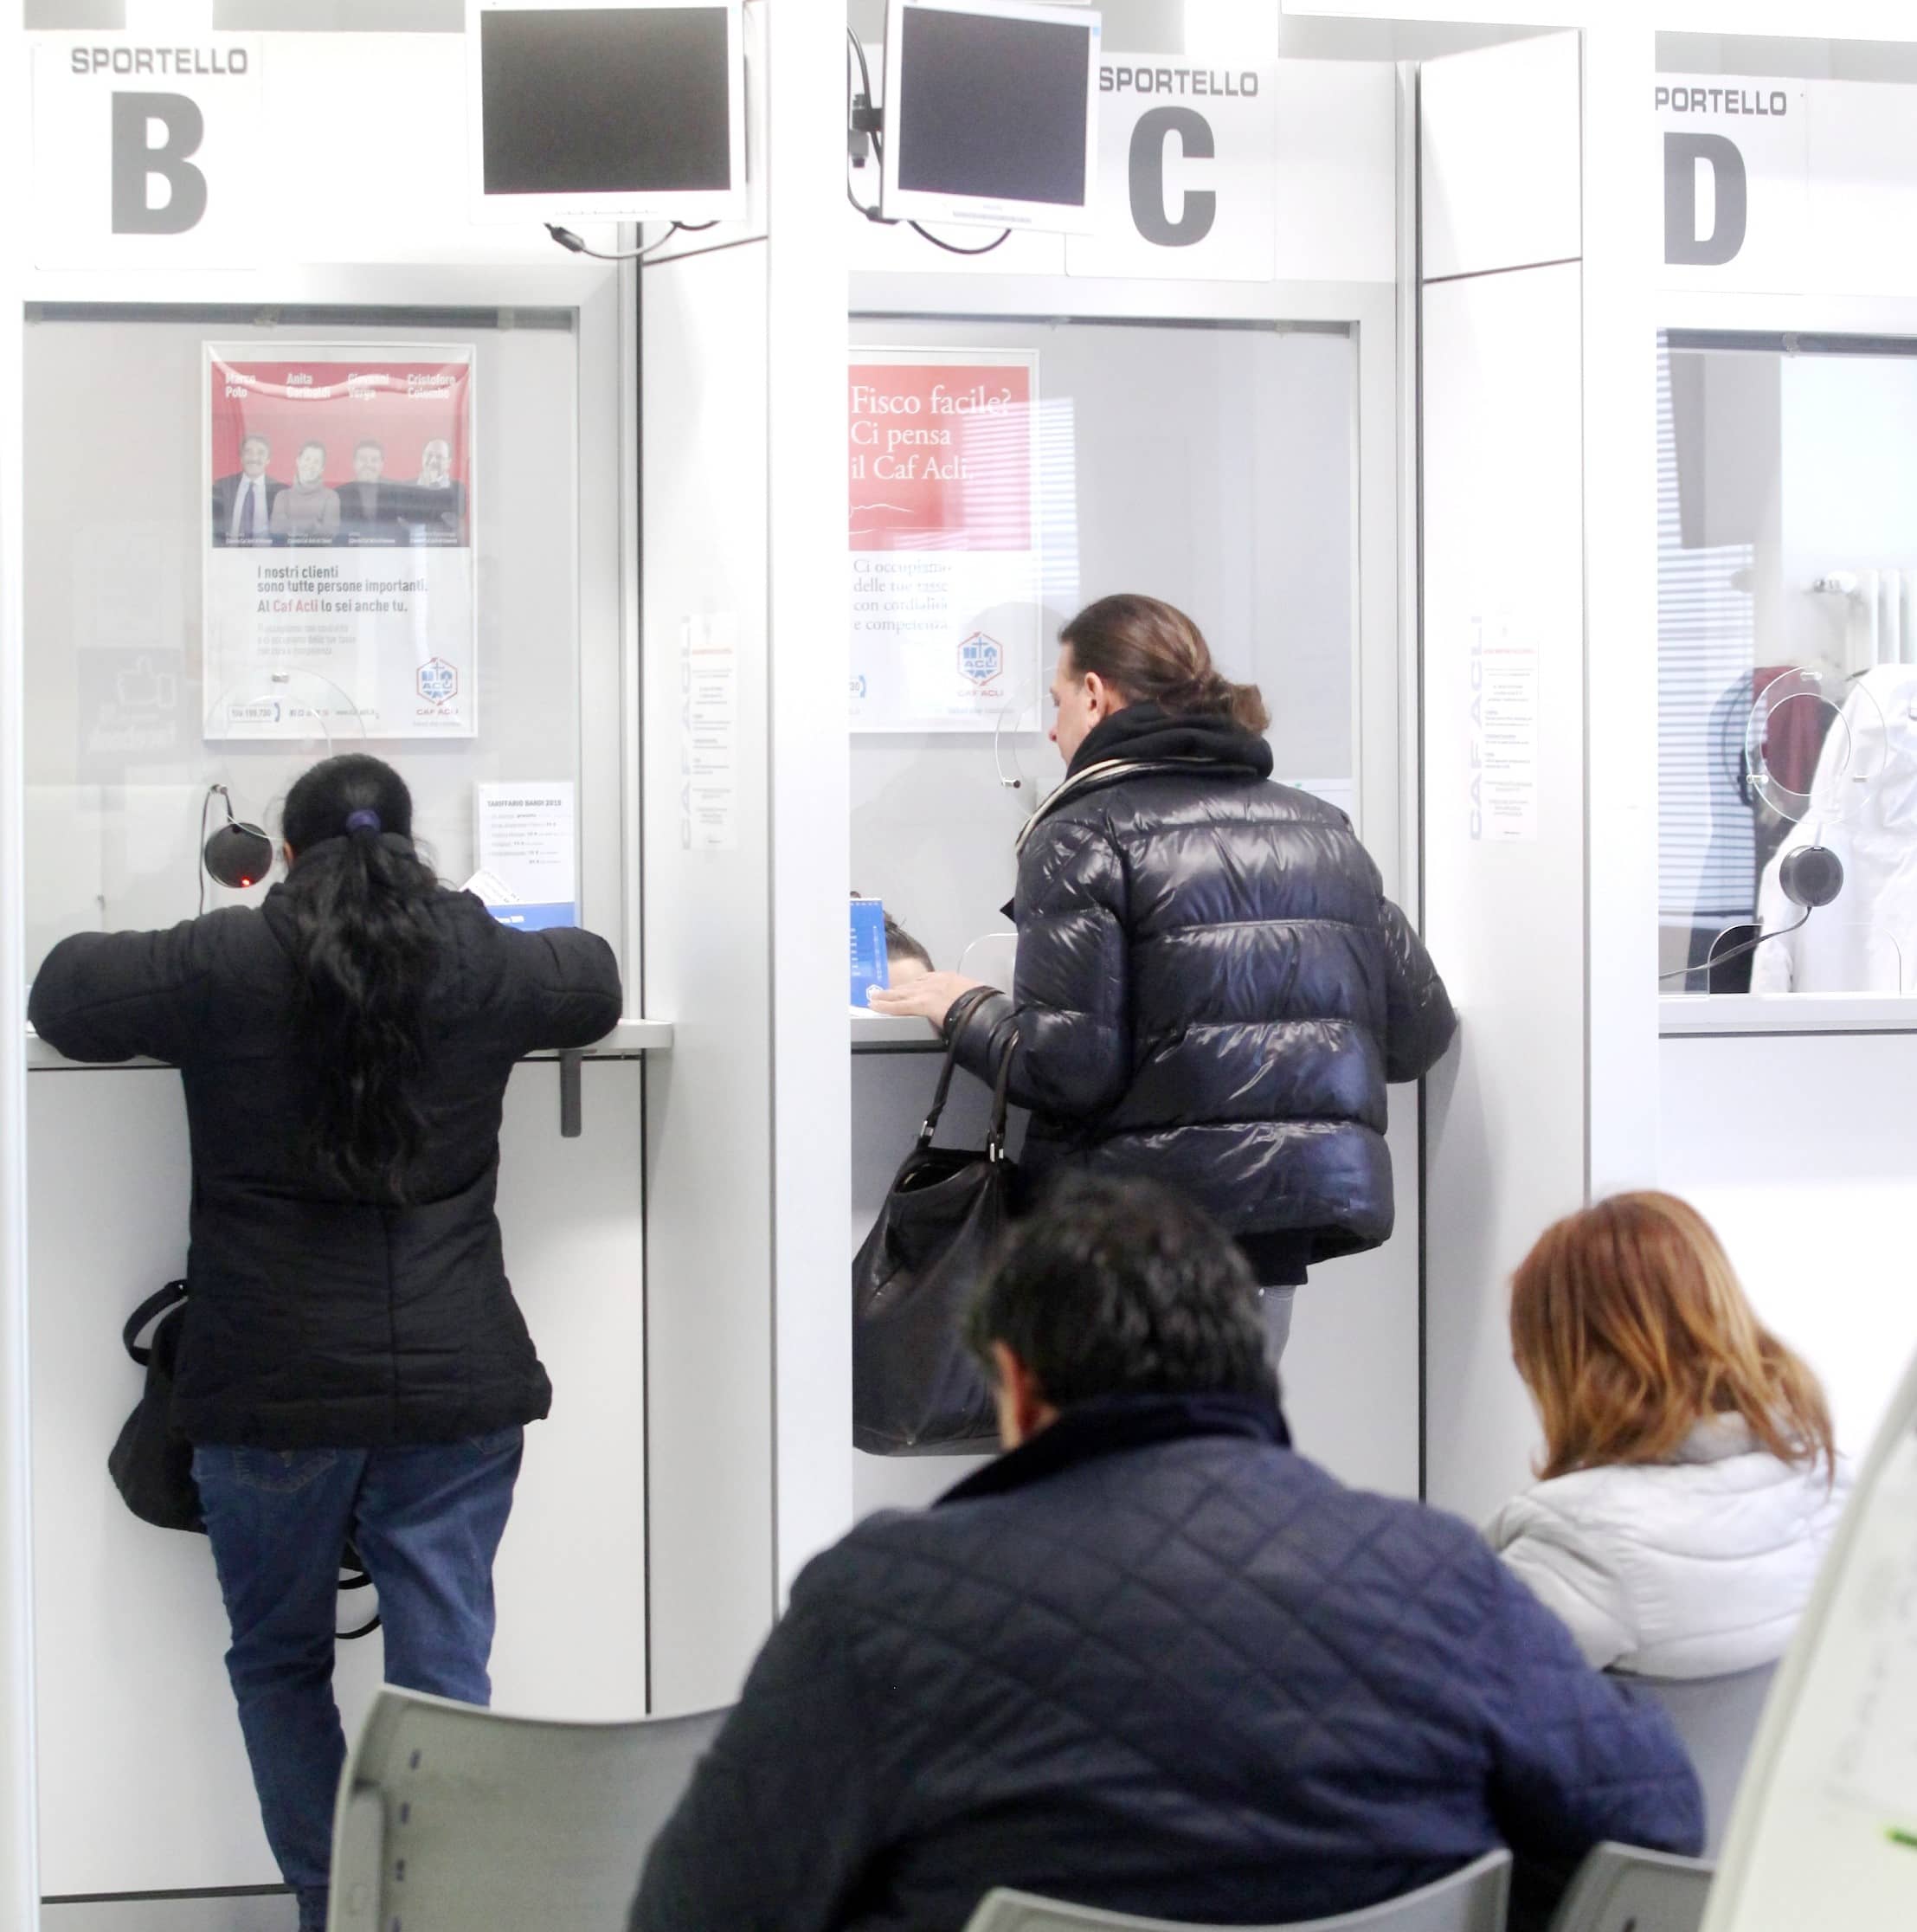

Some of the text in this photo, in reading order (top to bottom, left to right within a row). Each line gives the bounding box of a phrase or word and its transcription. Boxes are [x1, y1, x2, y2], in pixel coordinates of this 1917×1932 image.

[71, 48, 248, 75] SPORTELLO
[1099, 66, 1259, 97] SPORTELLO
[111, 91, 209, 235] B
[1128, 105, 1217, 248] C
[1663, 131, 1747, 267] D
[286, 372, 314, 385] Anita
[225, 387, 248, 399] Polo
[851, 384, 1012, 415] Fisco facile?
[850, 420, 952, 452] Ci pensa
[851, 454, 865, 480] il
[873, 454, 920, 480] Caf
[264, 565, 299, 578] nostri
[301, 565, 339, 578] clienti
[852, 558, 871, 573] Ci
[257, 579, 428, 596] sono tutte persone importanti.
[852, 576, 885, 592] delle
[257, 599, 408, 613] Al Caf Acli lo sei anche tu.
[852, 602, 879, 611] con
[852, 621, 861, 631] e
